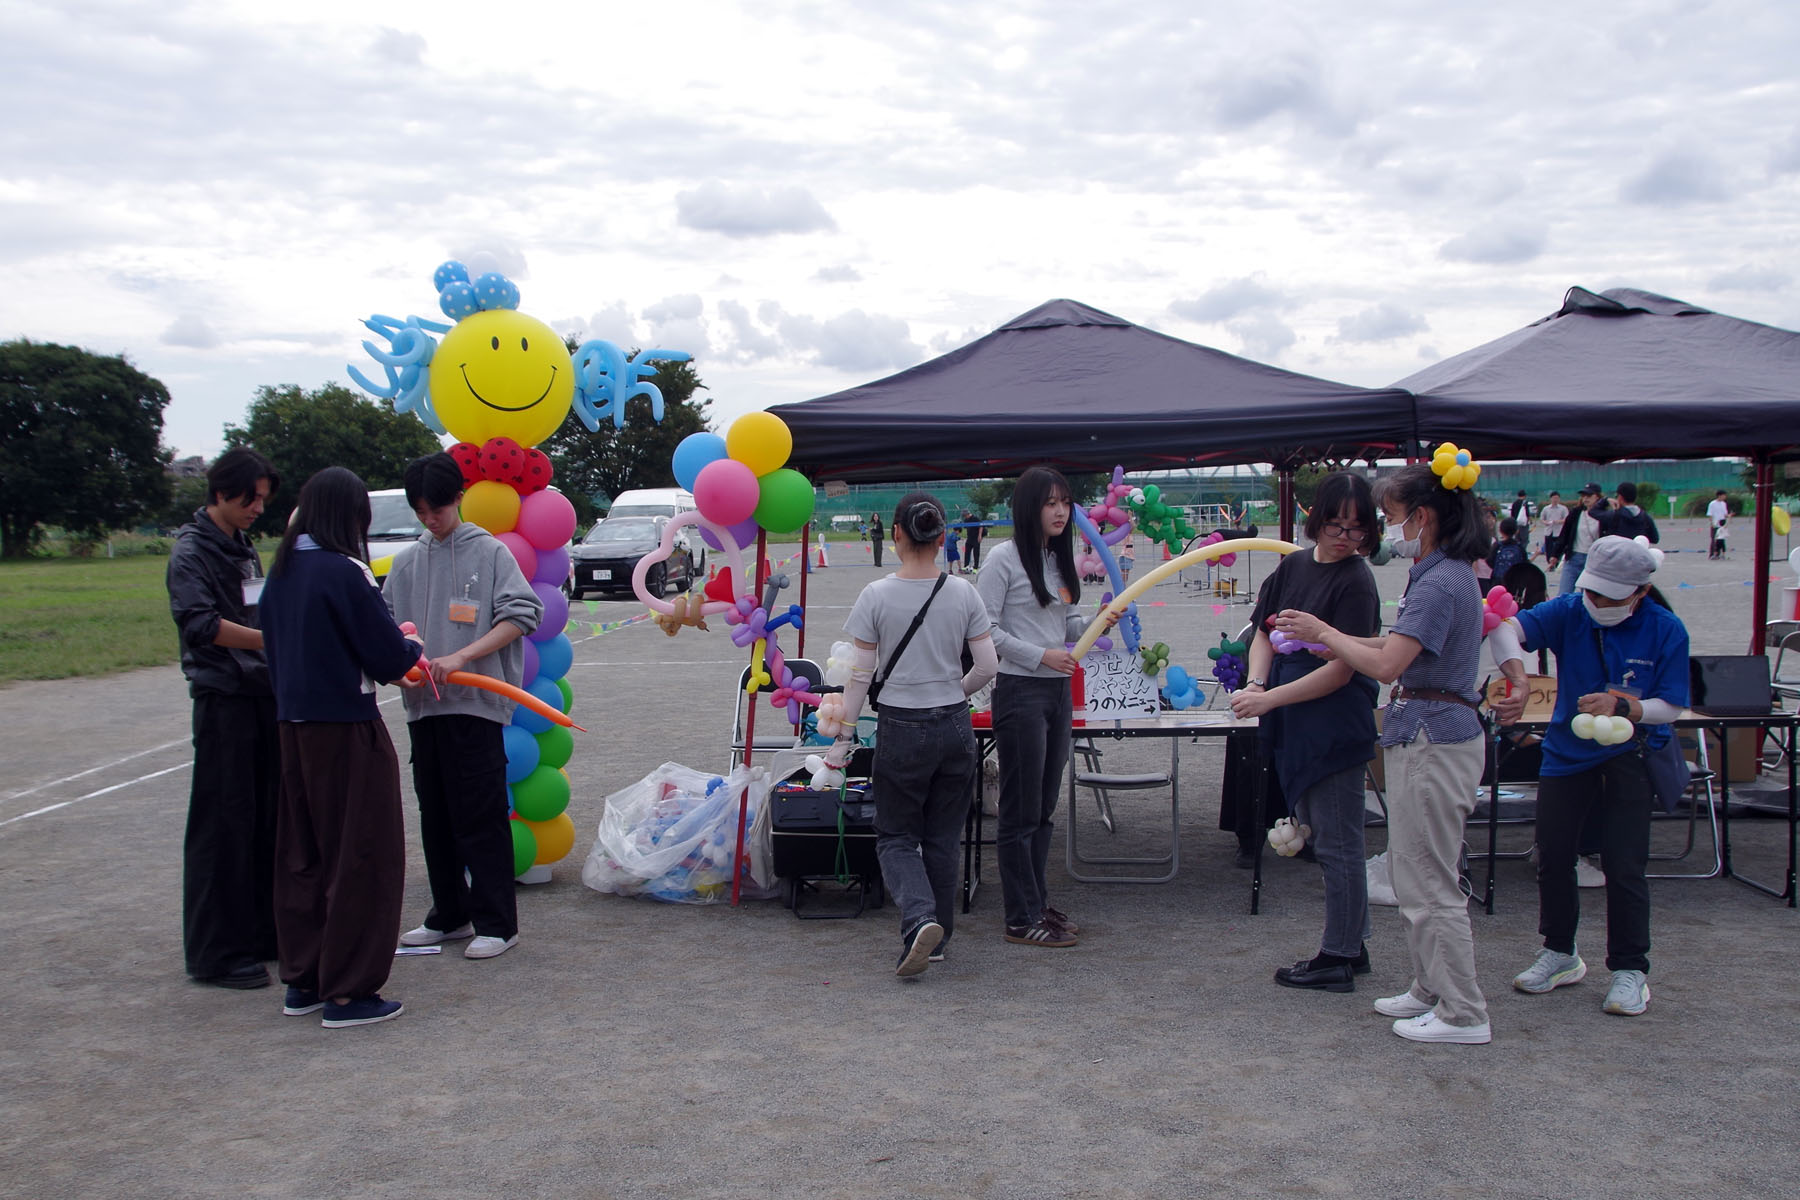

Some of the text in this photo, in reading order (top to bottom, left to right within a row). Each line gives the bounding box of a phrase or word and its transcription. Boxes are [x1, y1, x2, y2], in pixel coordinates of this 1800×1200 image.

[1084, 653, 1143, 678] うせん
[1085, 695, 1156, 713] うのメニュー
